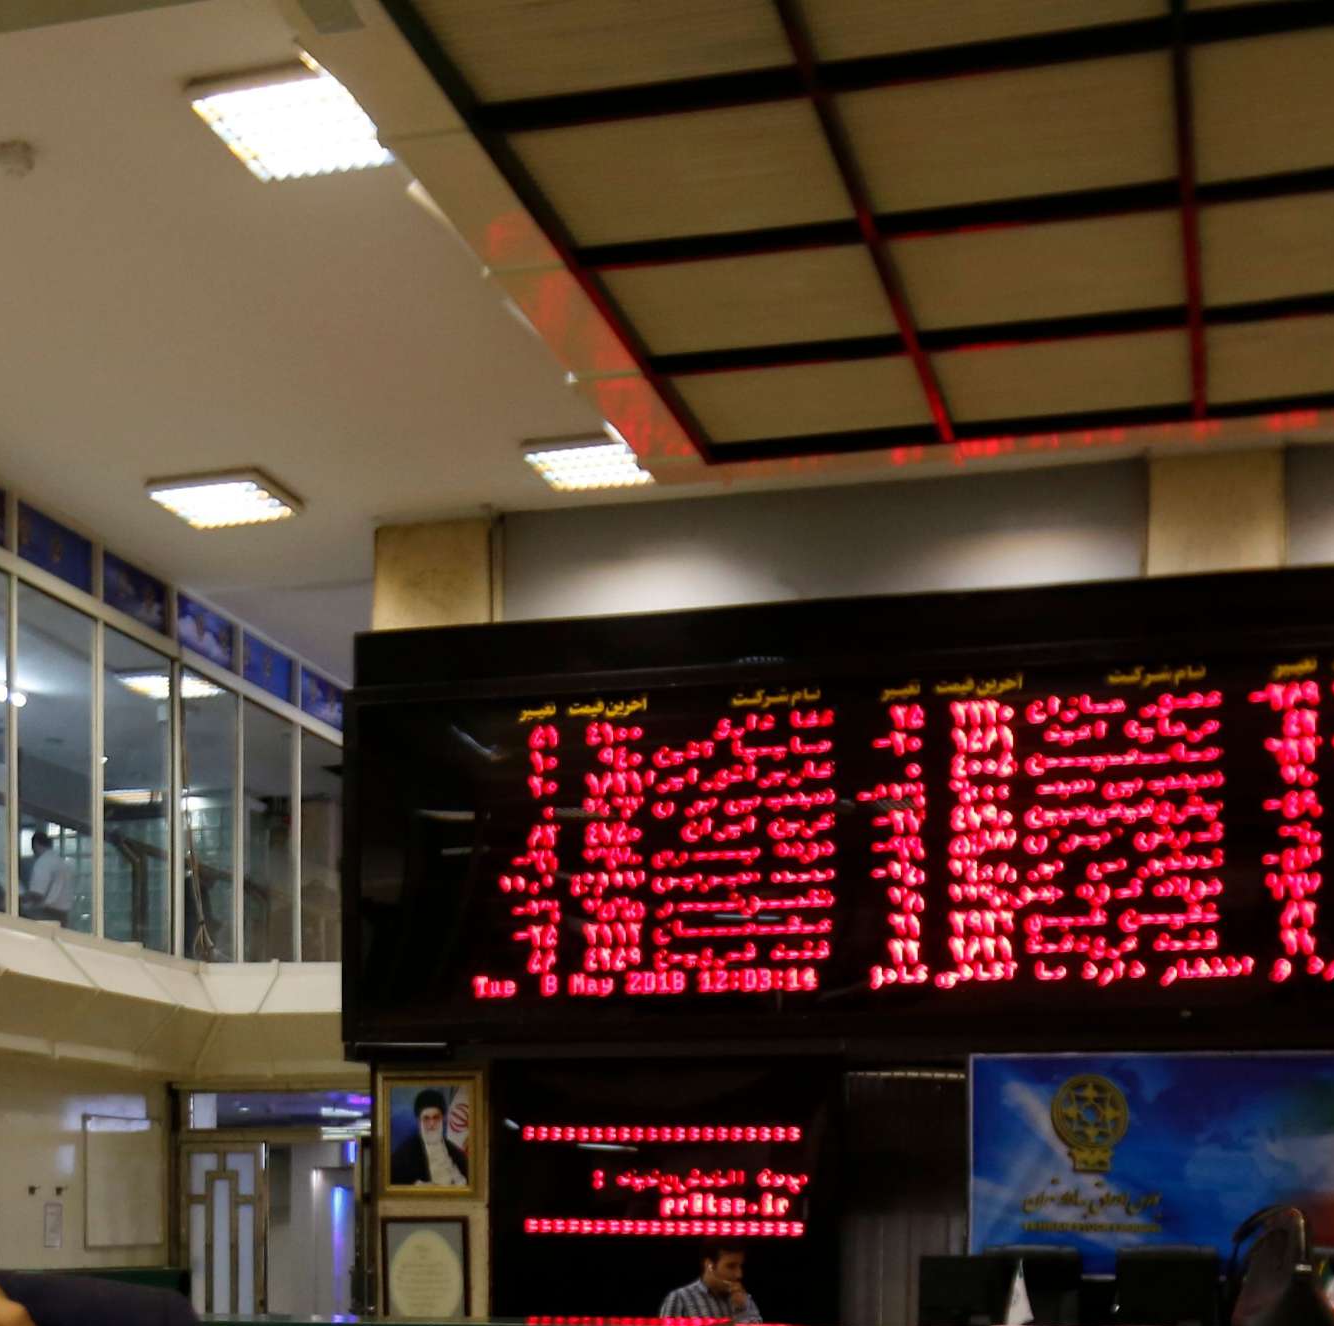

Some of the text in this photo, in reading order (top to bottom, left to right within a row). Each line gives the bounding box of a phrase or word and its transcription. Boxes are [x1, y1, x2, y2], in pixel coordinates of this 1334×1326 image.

[472, 975, 517, 999] Tue
[567, 971, 615, 997] May
[624, 970, 687, 996] 2018
[698, 966, 820, 994] 12:03:14
